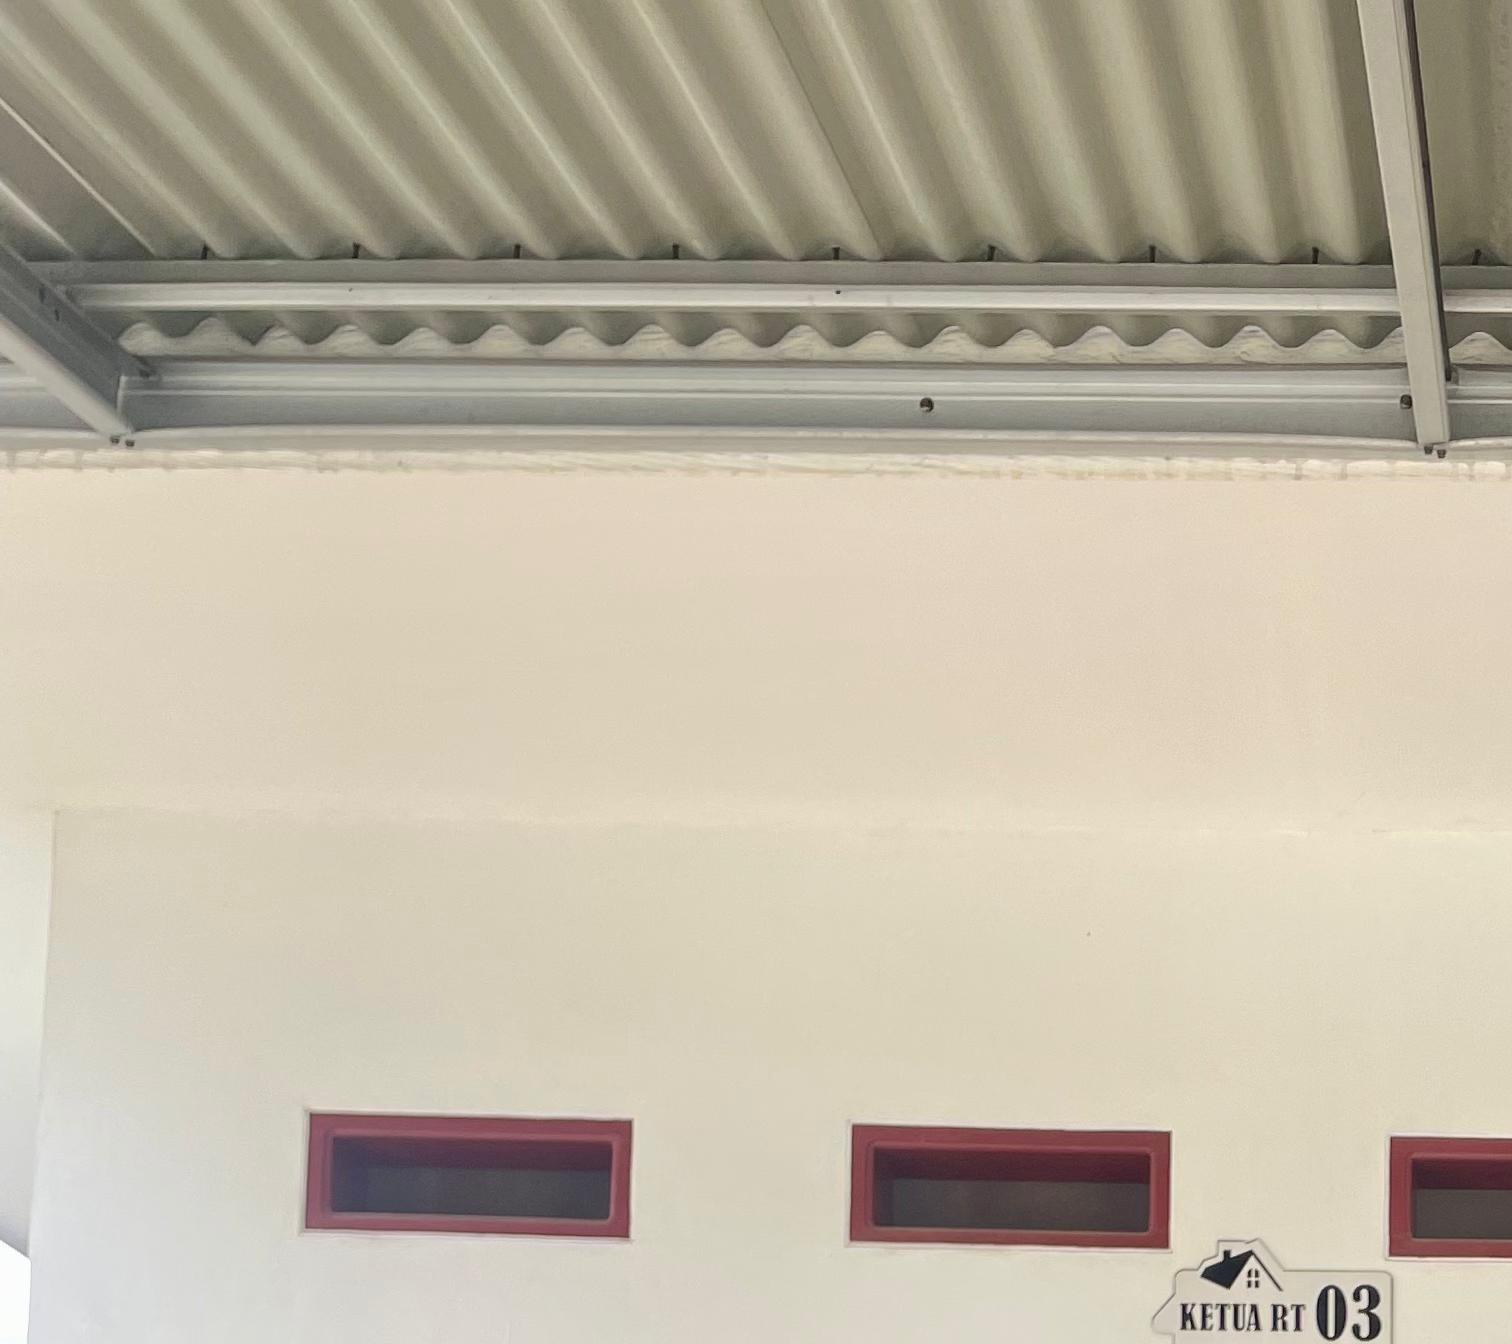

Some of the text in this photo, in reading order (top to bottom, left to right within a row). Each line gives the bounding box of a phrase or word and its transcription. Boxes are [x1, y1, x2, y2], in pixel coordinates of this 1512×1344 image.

[1180, 1284, 1382, 1342] KETUA RT 03
